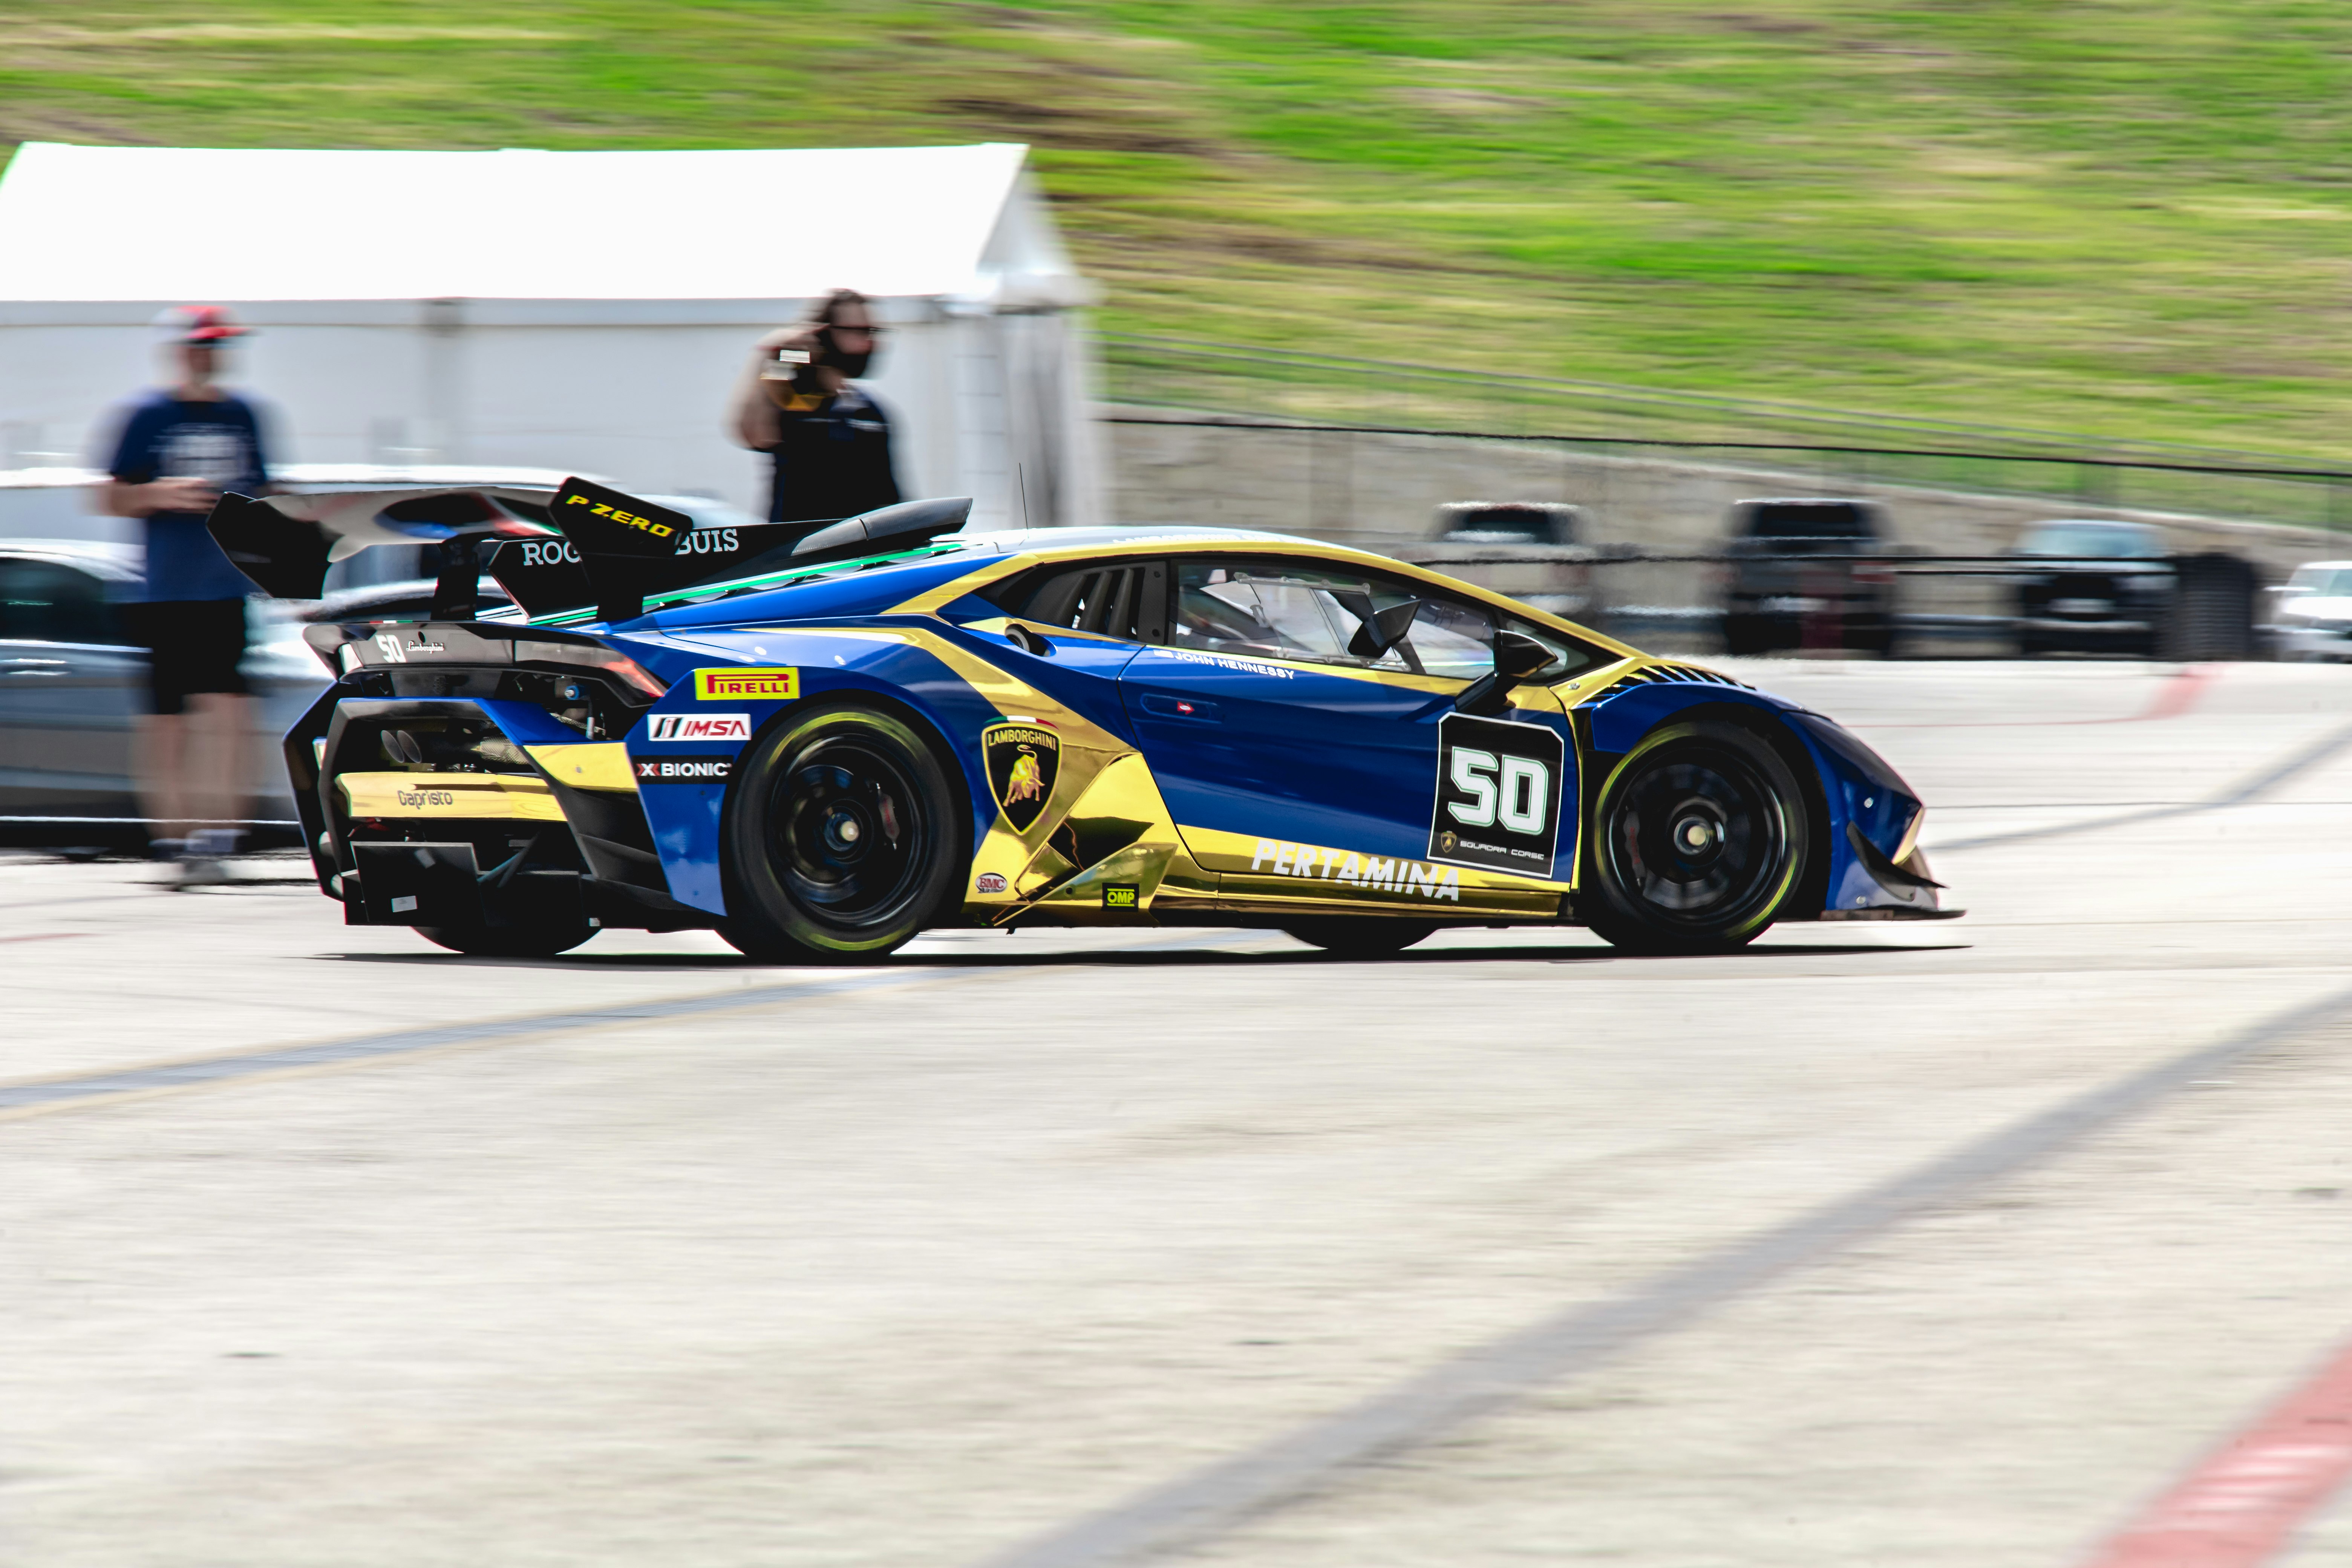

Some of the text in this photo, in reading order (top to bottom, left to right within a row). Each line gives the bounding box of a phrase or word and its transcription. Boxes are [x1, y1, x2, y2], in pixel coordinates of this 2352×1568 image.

[566, 495, 675, 537] P ZERO
[521, 528, 739, 565] ROG BUIS
[375, 634, 407, 663] 50
[406, 640, 444, 654] Lamborghini
[1174, 652, 1294, 679] JOHN HENNESSY
[706, 674, 790, 694] PIRELLI
[682, 721, 747, 736] IMSA
[988, 730, 1056, 751] LAMBORGHINI
[397, 790, 453, 810] Capristo
[1448, 746, 1548, 836] 50
[1460, 840, 1544, 861] SQUADRA CORSE
[1251, 839, 1459, 902] PERTAMINA
[979, 877, 1004, 888] BMC
[1107, 891, 1135, 904] OMP
